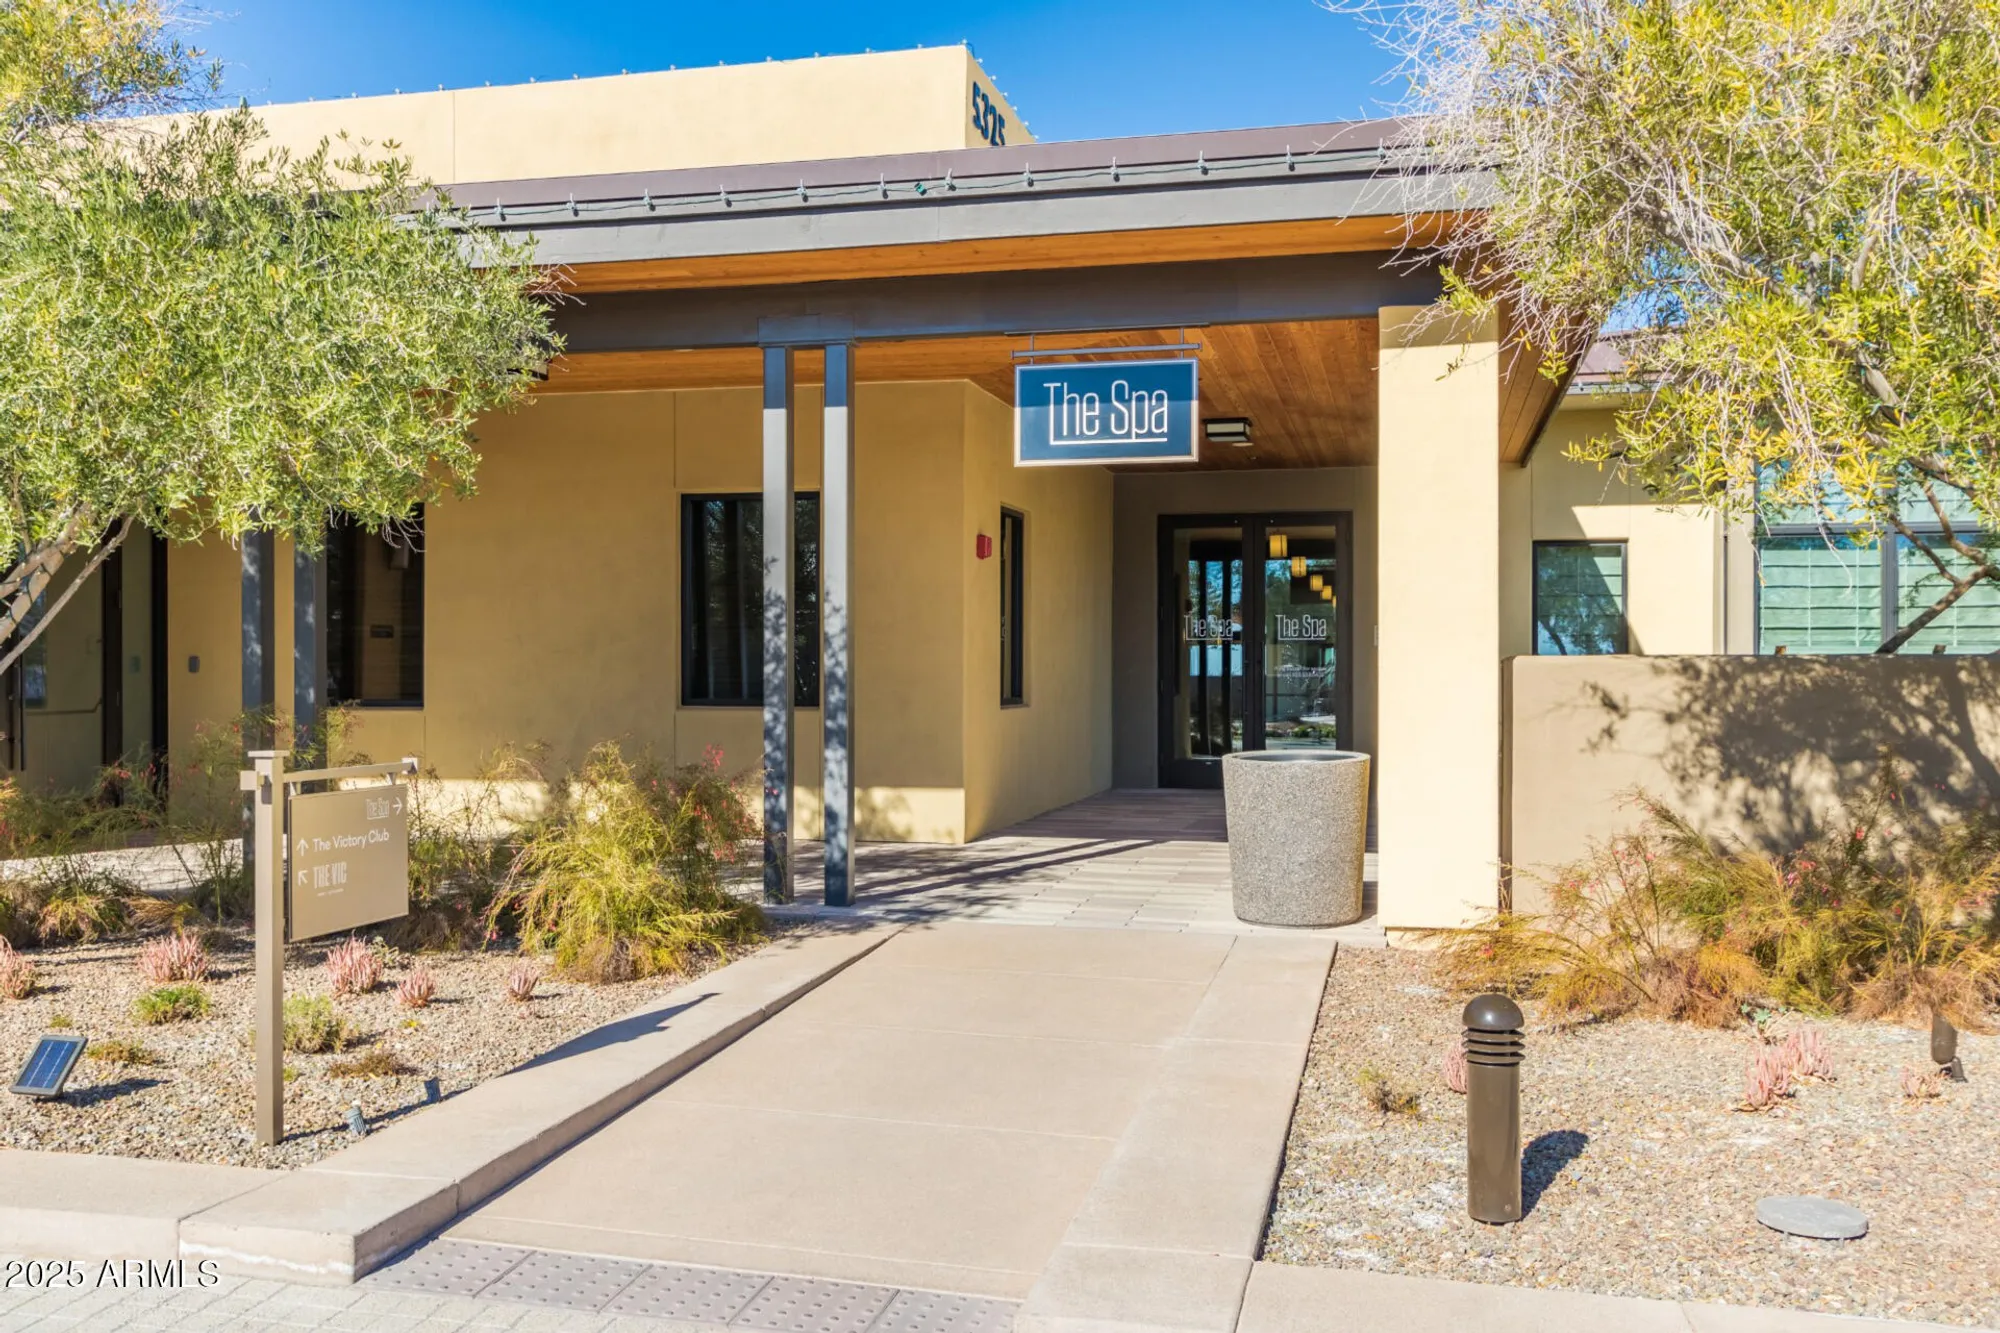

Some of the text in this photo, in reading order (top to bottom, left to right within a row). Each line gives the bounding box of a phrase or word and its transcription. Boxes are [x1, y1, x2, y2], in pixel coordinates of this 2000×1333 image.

[1043, 380, 1168, 445] The Spa
[1183, 614, 1234, 640] The Spa
[1275, 614, 1327, 640] The Spa
[312, 828, 390, 852] The Victory Club
[313, 861, 347, 889] THE VIC
